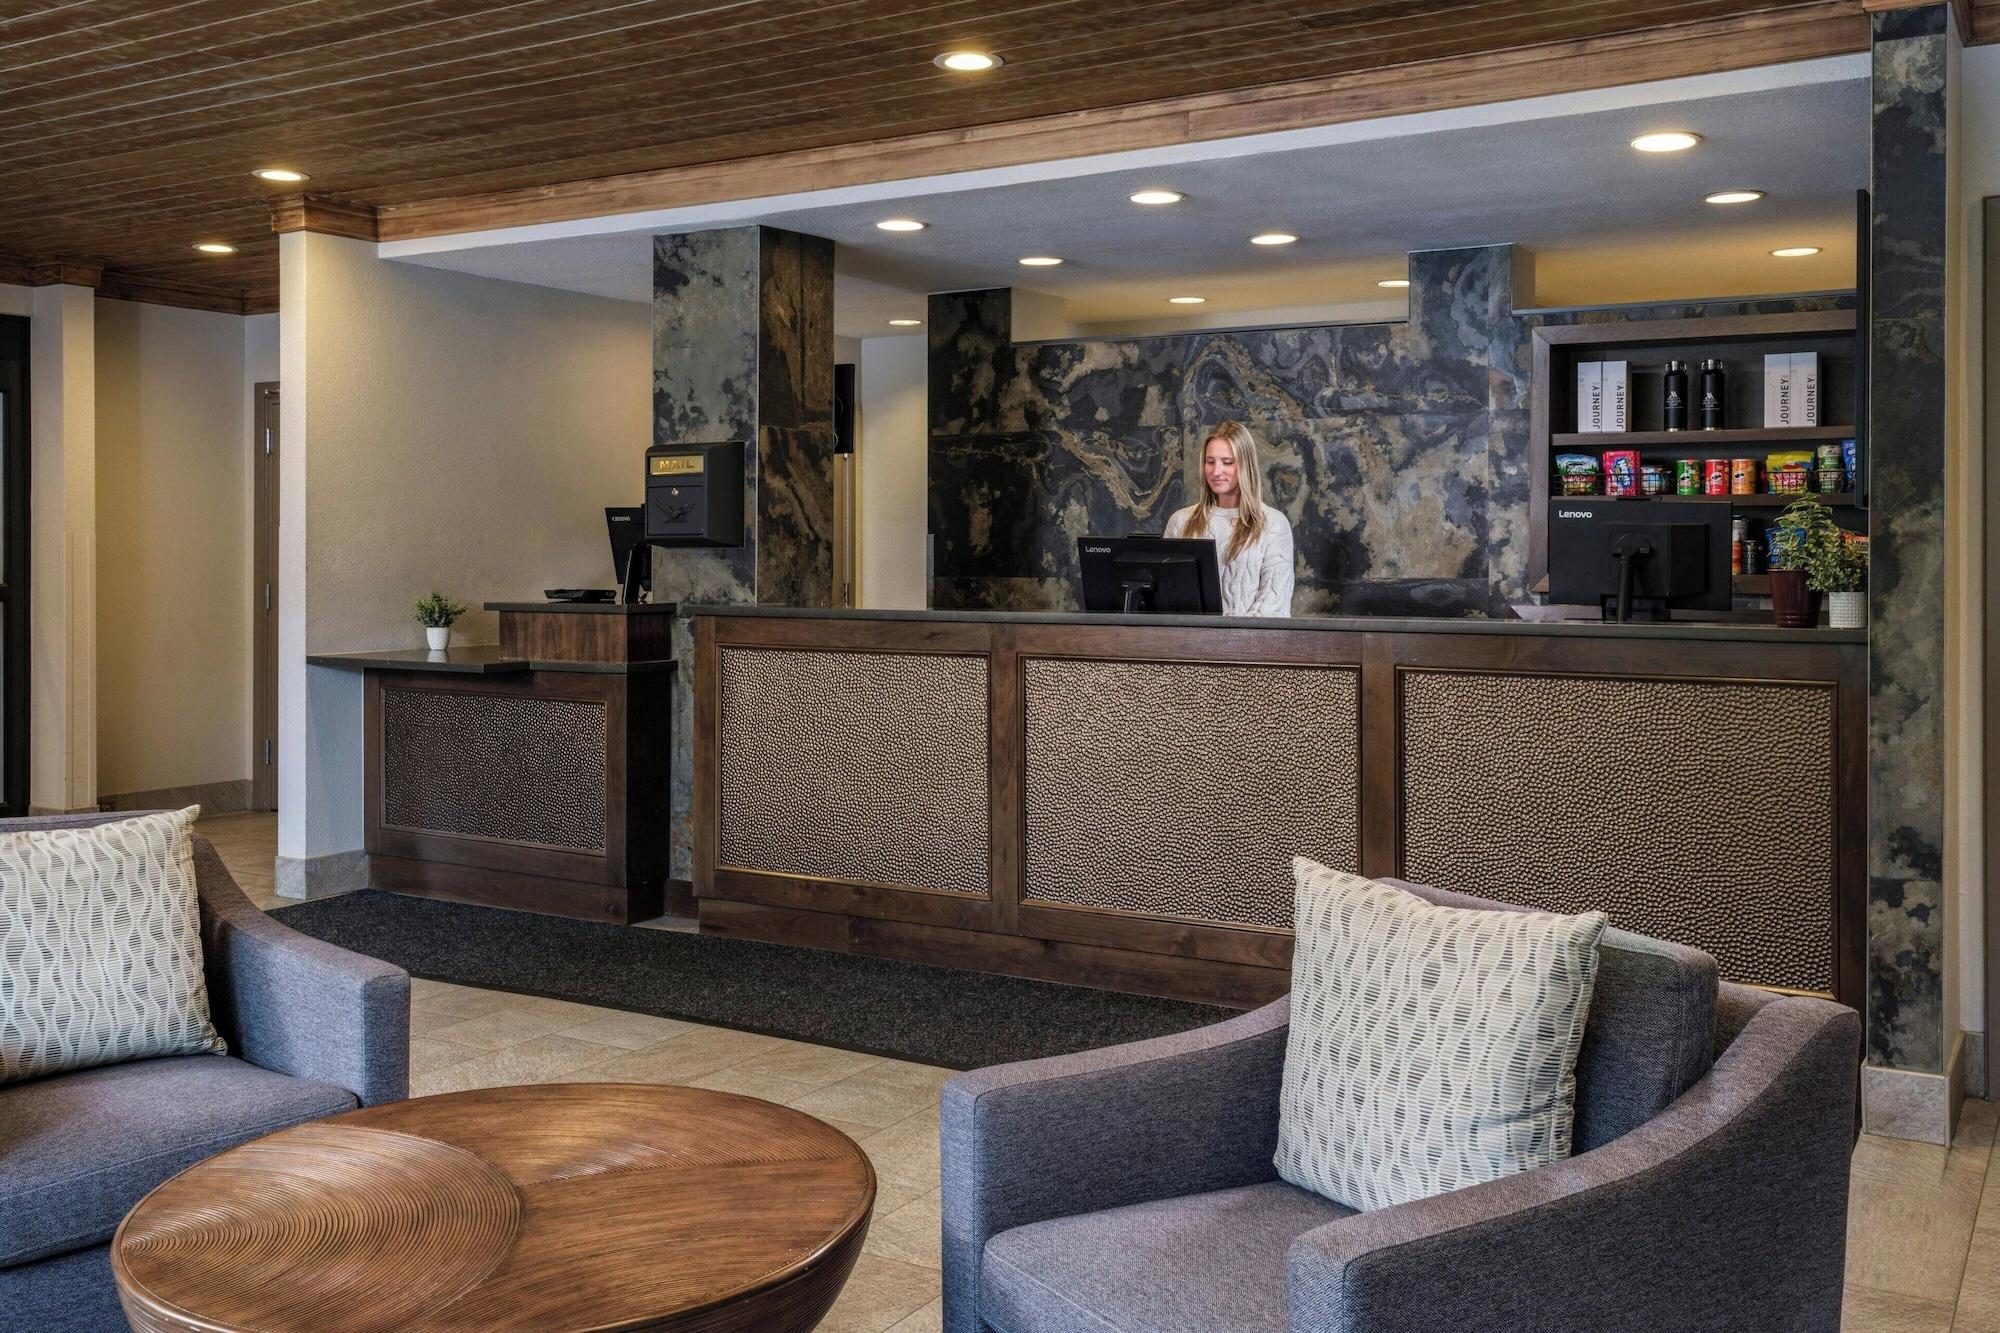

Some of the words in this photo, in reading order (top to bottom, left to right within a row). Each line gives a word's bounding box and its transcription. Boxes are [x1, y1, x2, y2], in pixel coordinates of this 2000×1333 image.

[1592, 385, 1601, 430] JOURNEY
[1616, 385, 1625, 430] JOURNEY
[1780, 378, 1790, 425] JOURNEY
[1806, 377, 1816, 424] JOURNEY
[660, 460, 694, 469] MAIL
[1558, 509, 1593, 519] Lenovo
[1084, 545, 1112, 554] Lenovo
